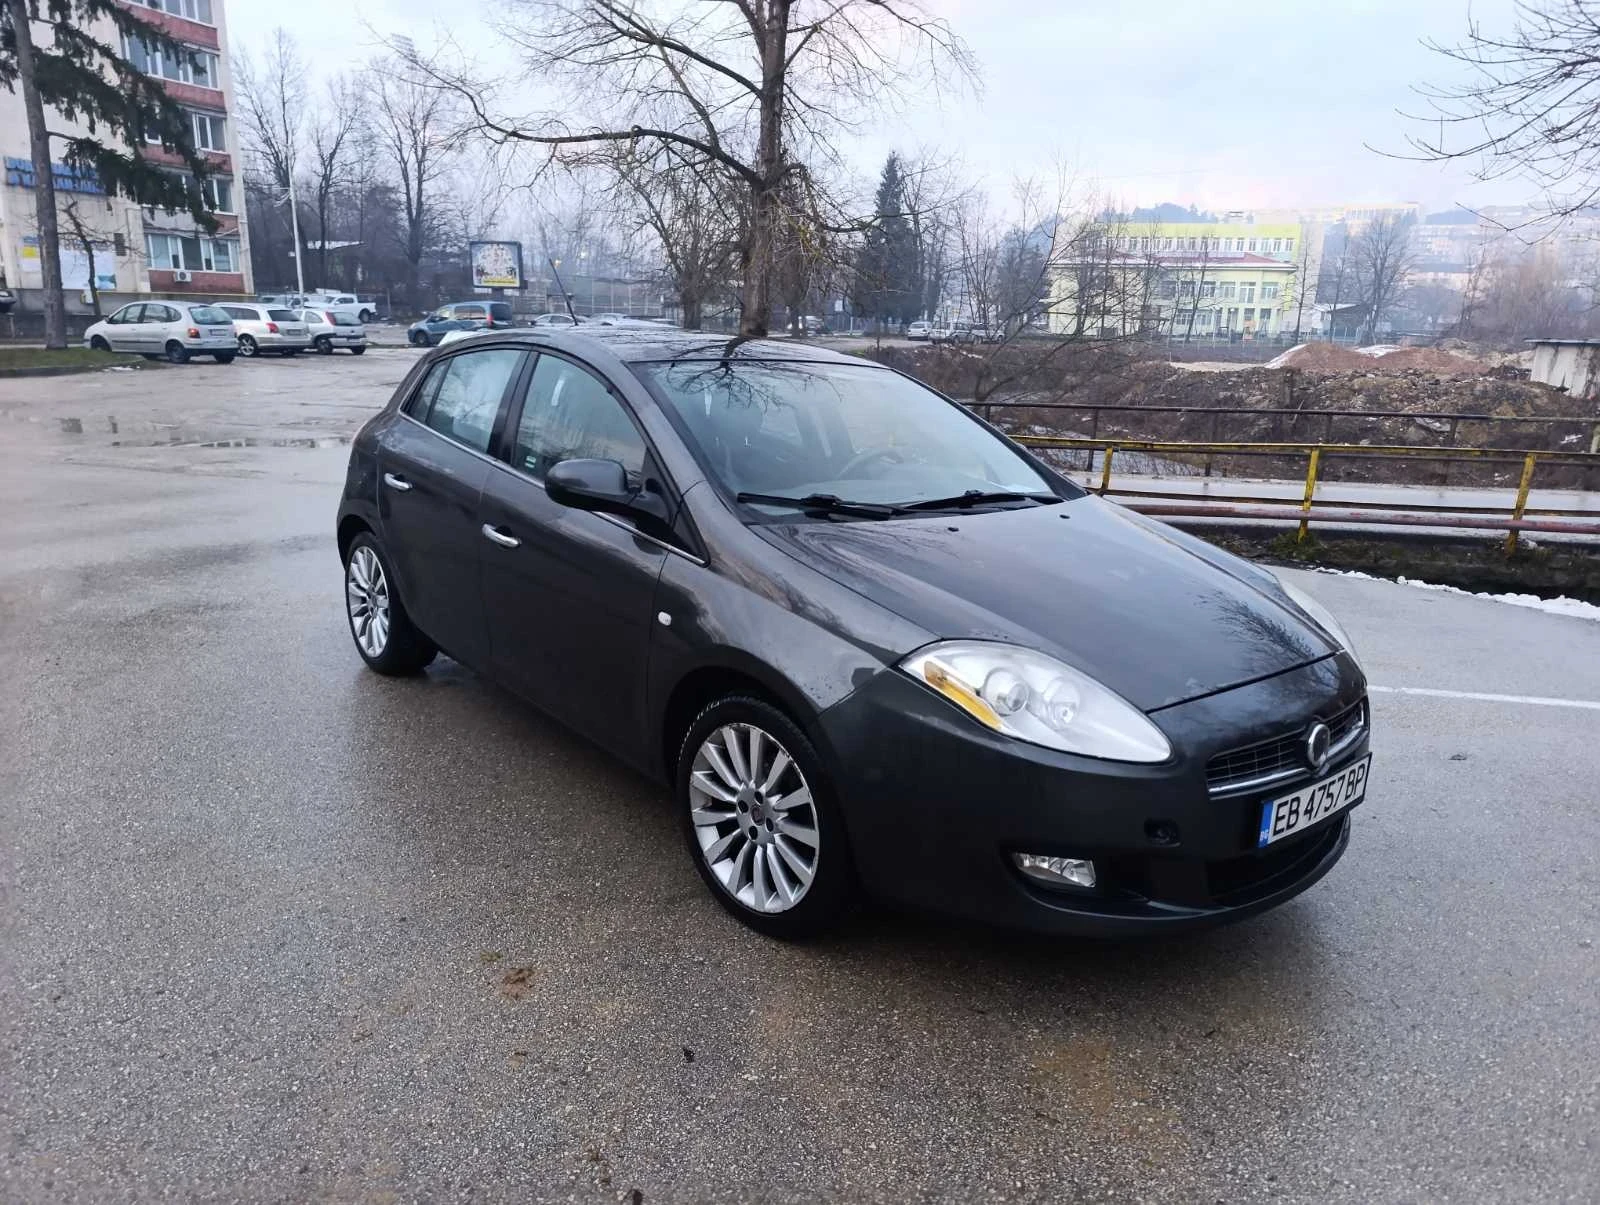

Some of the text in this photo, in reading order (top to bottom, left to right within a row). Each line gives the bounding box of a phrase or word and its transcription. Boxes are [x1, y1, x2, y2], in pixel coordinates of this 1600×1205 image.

[1273, 763, 1365, 837] EB 4757 BP
